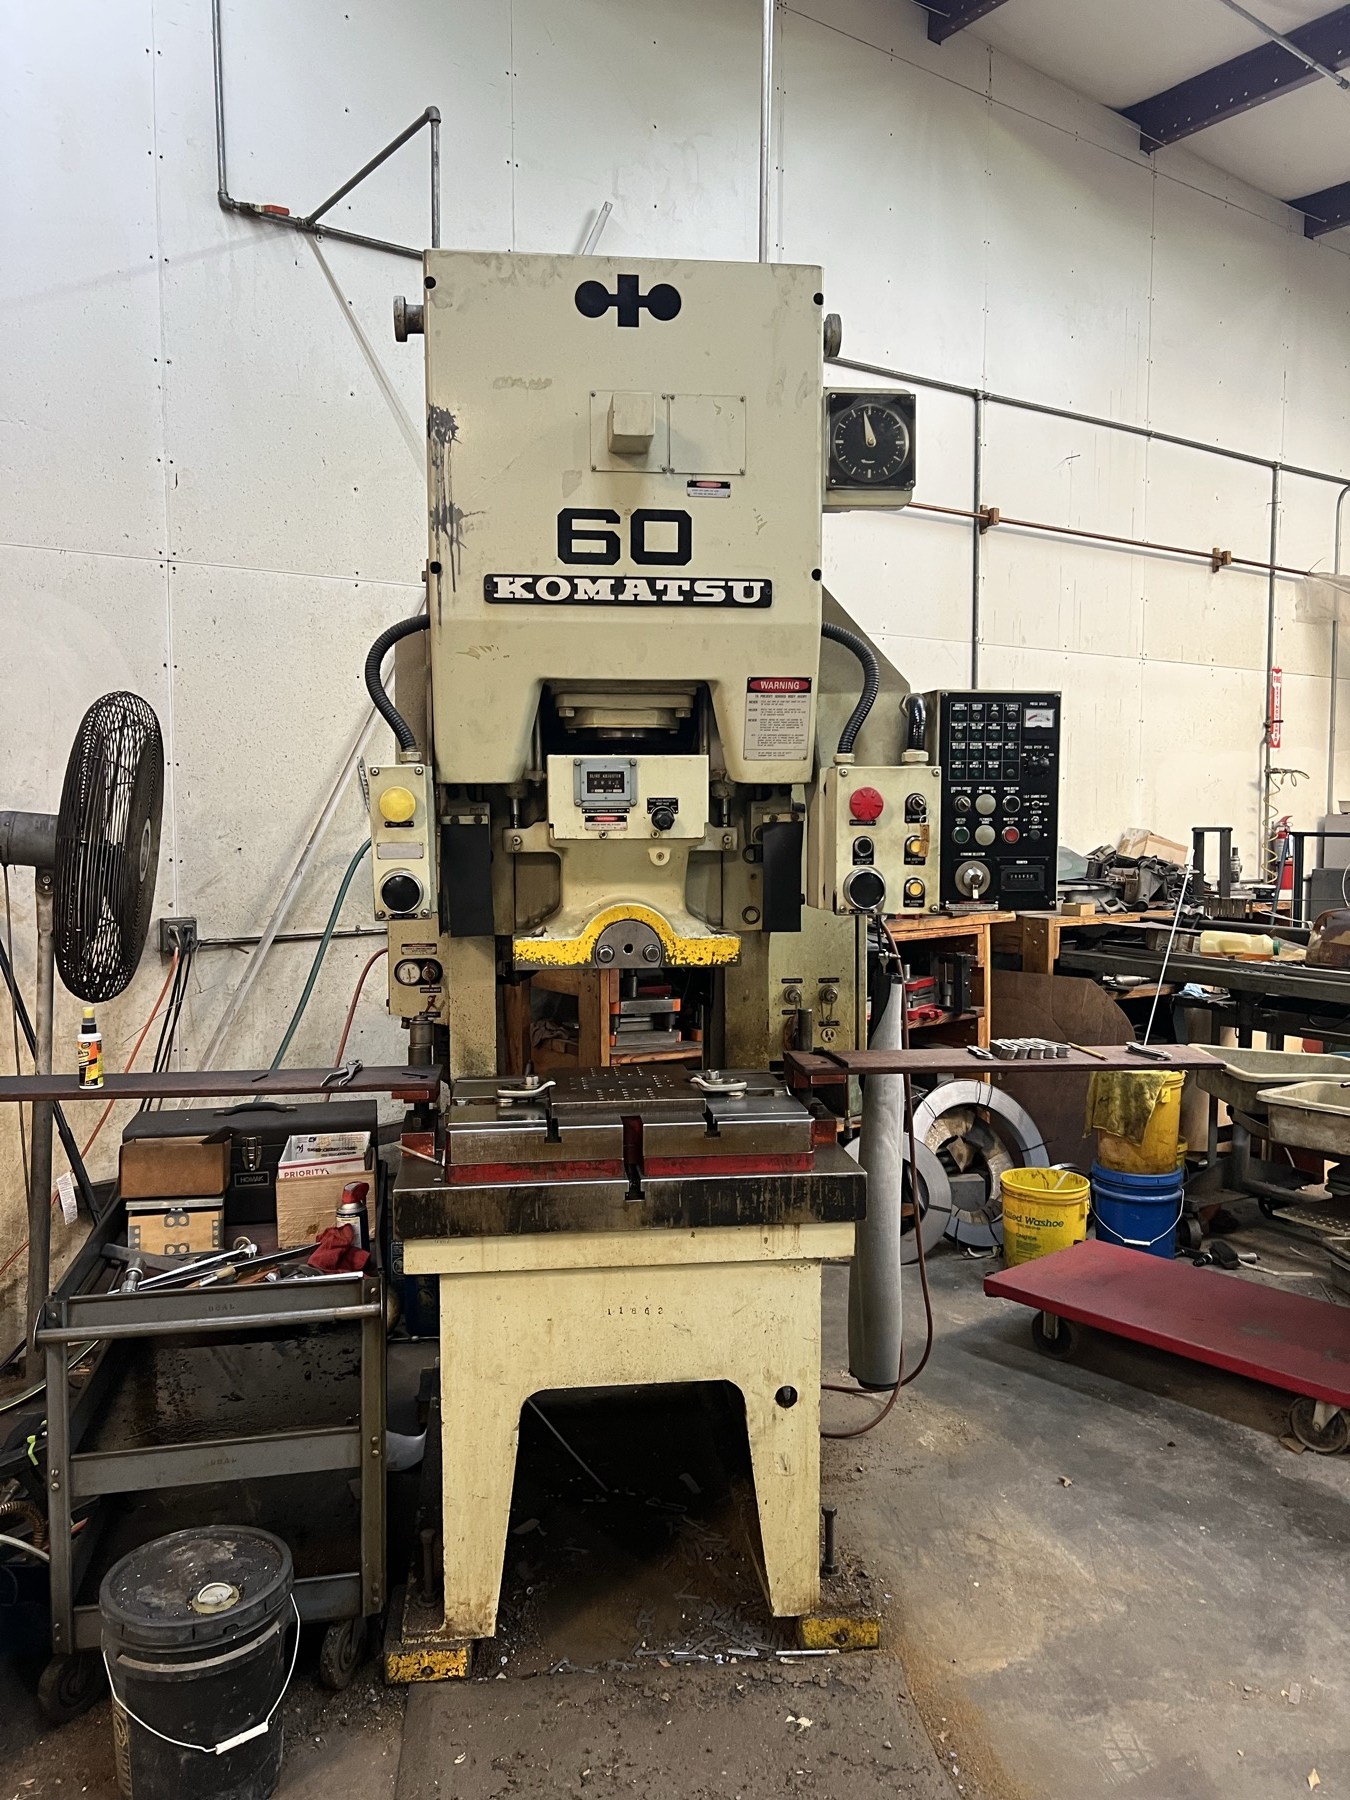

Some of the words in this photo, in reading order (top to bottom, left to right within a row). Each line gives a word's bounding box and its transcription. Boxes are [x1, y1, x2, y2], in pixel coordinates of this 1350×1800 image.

[557, 508, 692, 565] 60
[493, 576, 765, 604] KOMATSU
[760, 681, 800, 690] WARNING
[239, 1174, 264, 1184] HOMAK
[284, 1168, 324, 1179] PRIORITY
[1025, 1216, 1064, 1228] Washoe
